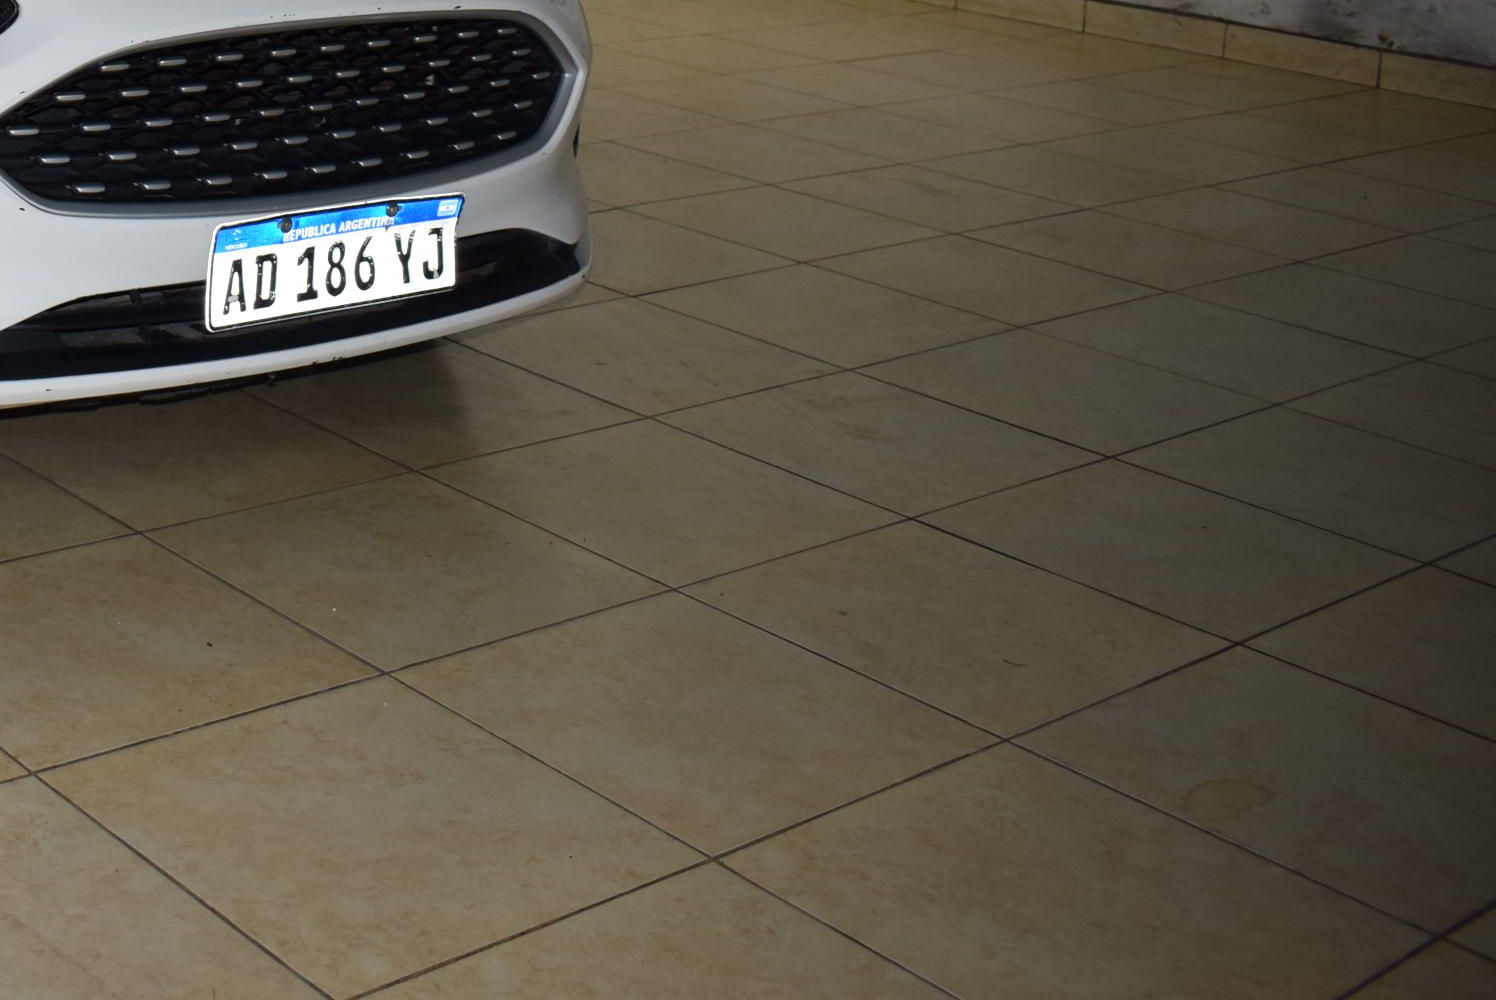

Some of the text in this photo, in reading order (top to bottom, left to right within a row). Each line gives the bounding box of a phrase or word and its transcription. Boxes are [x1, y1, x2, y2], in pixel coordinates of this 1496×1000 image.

[338, 215, 396, 233] ARGENTINA
[222, 227, 444, 316] AD 186 YJ
